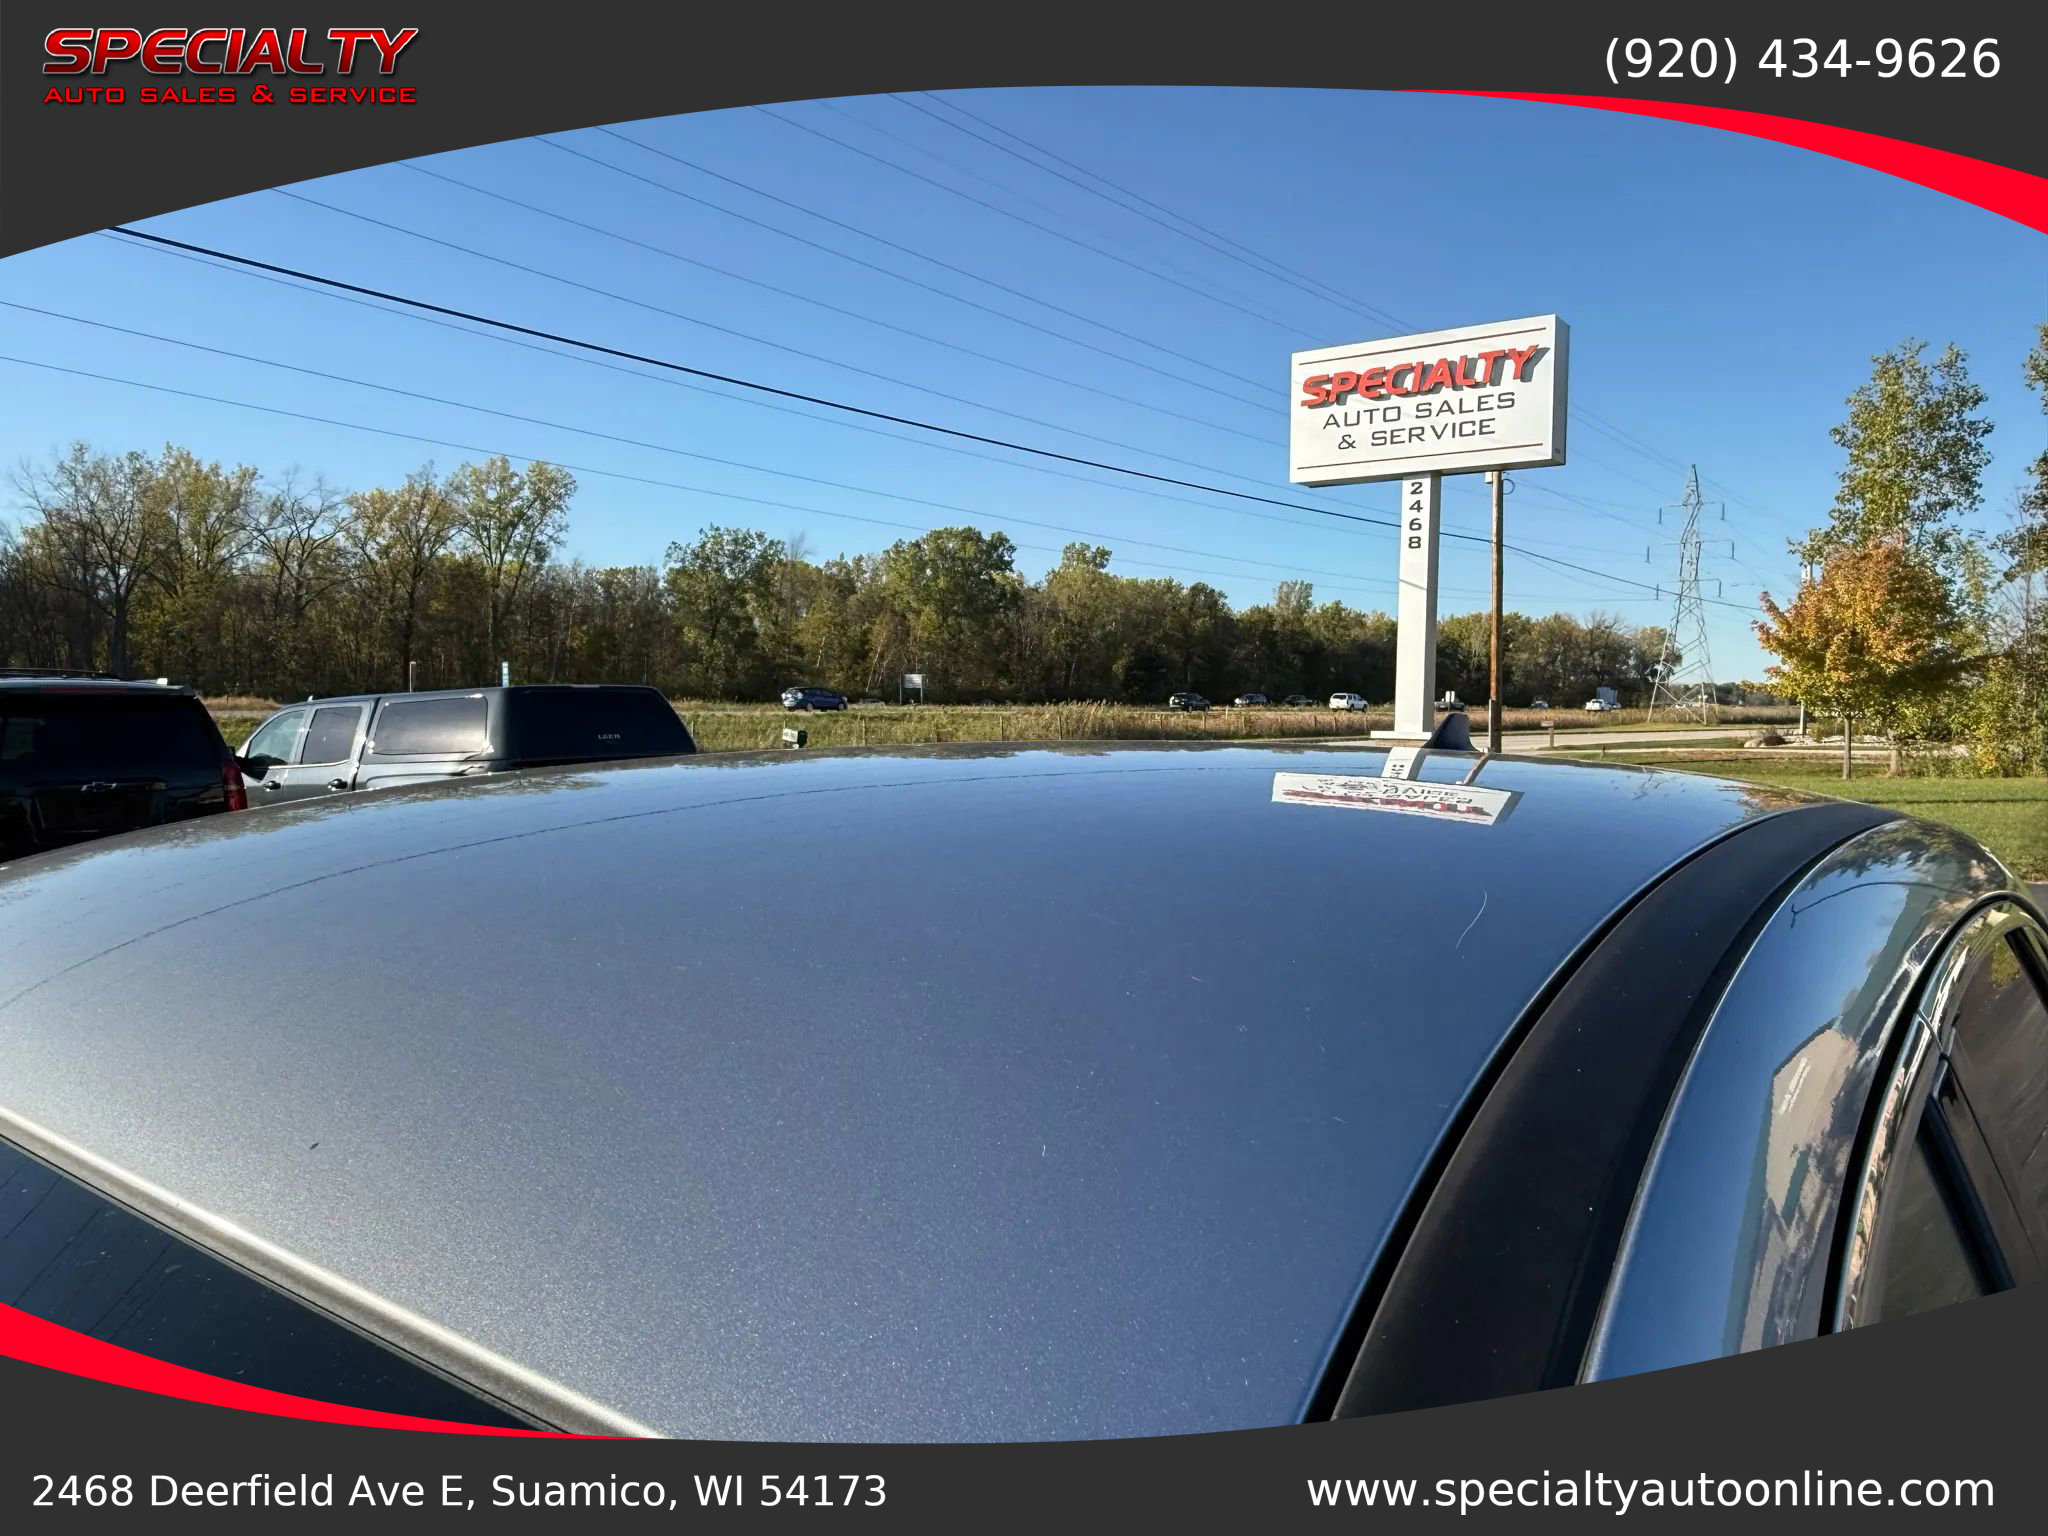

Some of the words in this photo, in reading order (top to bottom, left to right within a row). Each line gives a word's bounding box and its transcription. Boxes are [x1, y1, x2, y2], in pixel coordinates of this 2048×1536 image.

[1300, 344, 1550, 409] SPECIALTY
[1323, 405, 1401, 430] AUTO
[1415, 391, 1516, 419] SALES
[1337, 434, 1357, 450] &
[1371, 418, 1496, 447] SERVICE
[1407, 481, 1424, 550] 2468
